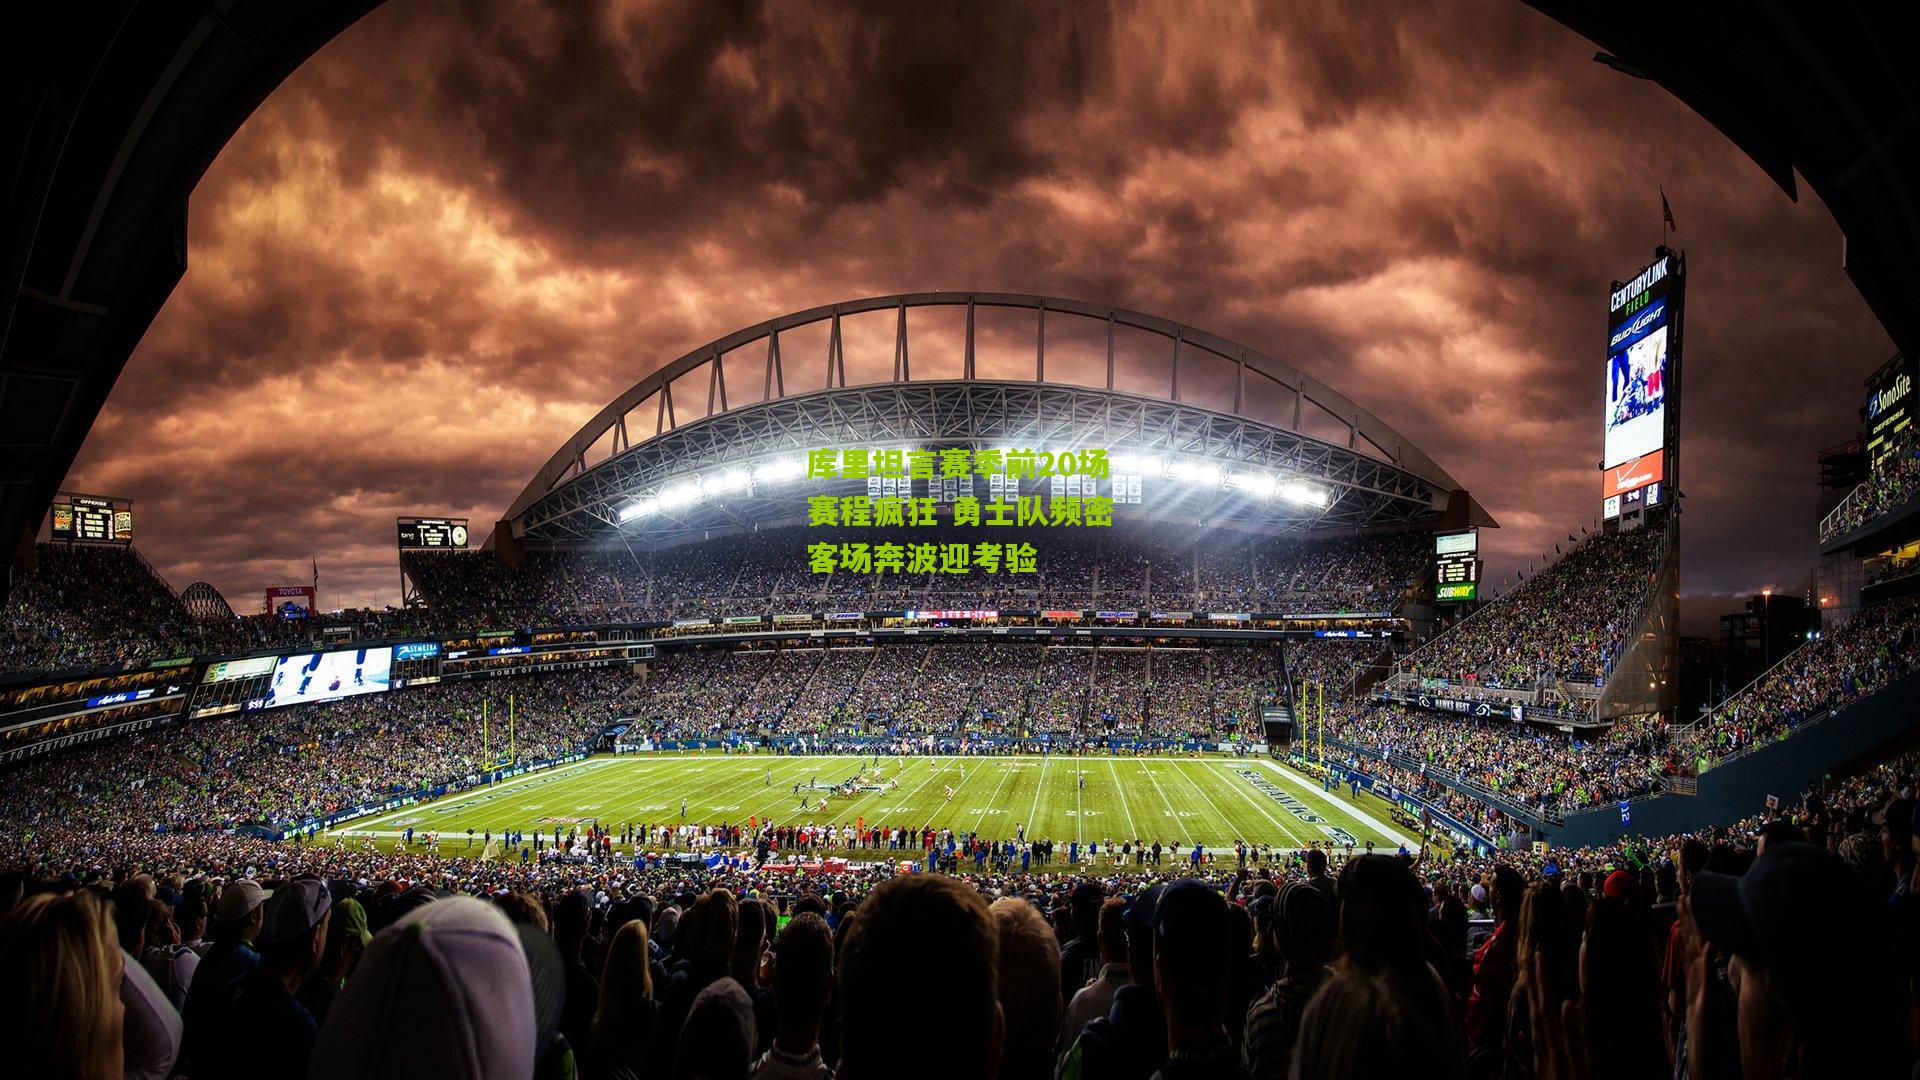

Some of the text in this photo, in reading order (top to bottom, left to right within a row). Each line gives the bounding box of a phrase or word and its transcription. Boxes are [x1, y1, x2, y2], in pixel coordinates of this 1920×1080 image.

[1611, 256, 1668, 313] CENTURYLINK
[1625, 290, 1649, 316] FIELD
[1611, 305, 1664, 347] BUD LIGHT
[1877, 373, 1911, 414] SonoSite
[80, 499, 107, 507] OFFENSE
[401, 532, 414, 540] bing
[279, 588, 303, 596] TOYOTA
[1437, 585, 1474, 598] SUBWAY
[410, 644, 437, 652] SYMETRA
[10, 720, 152, 761] TO CENTURYLINK FIELD
[1621, 806, 1630, 822] 12
